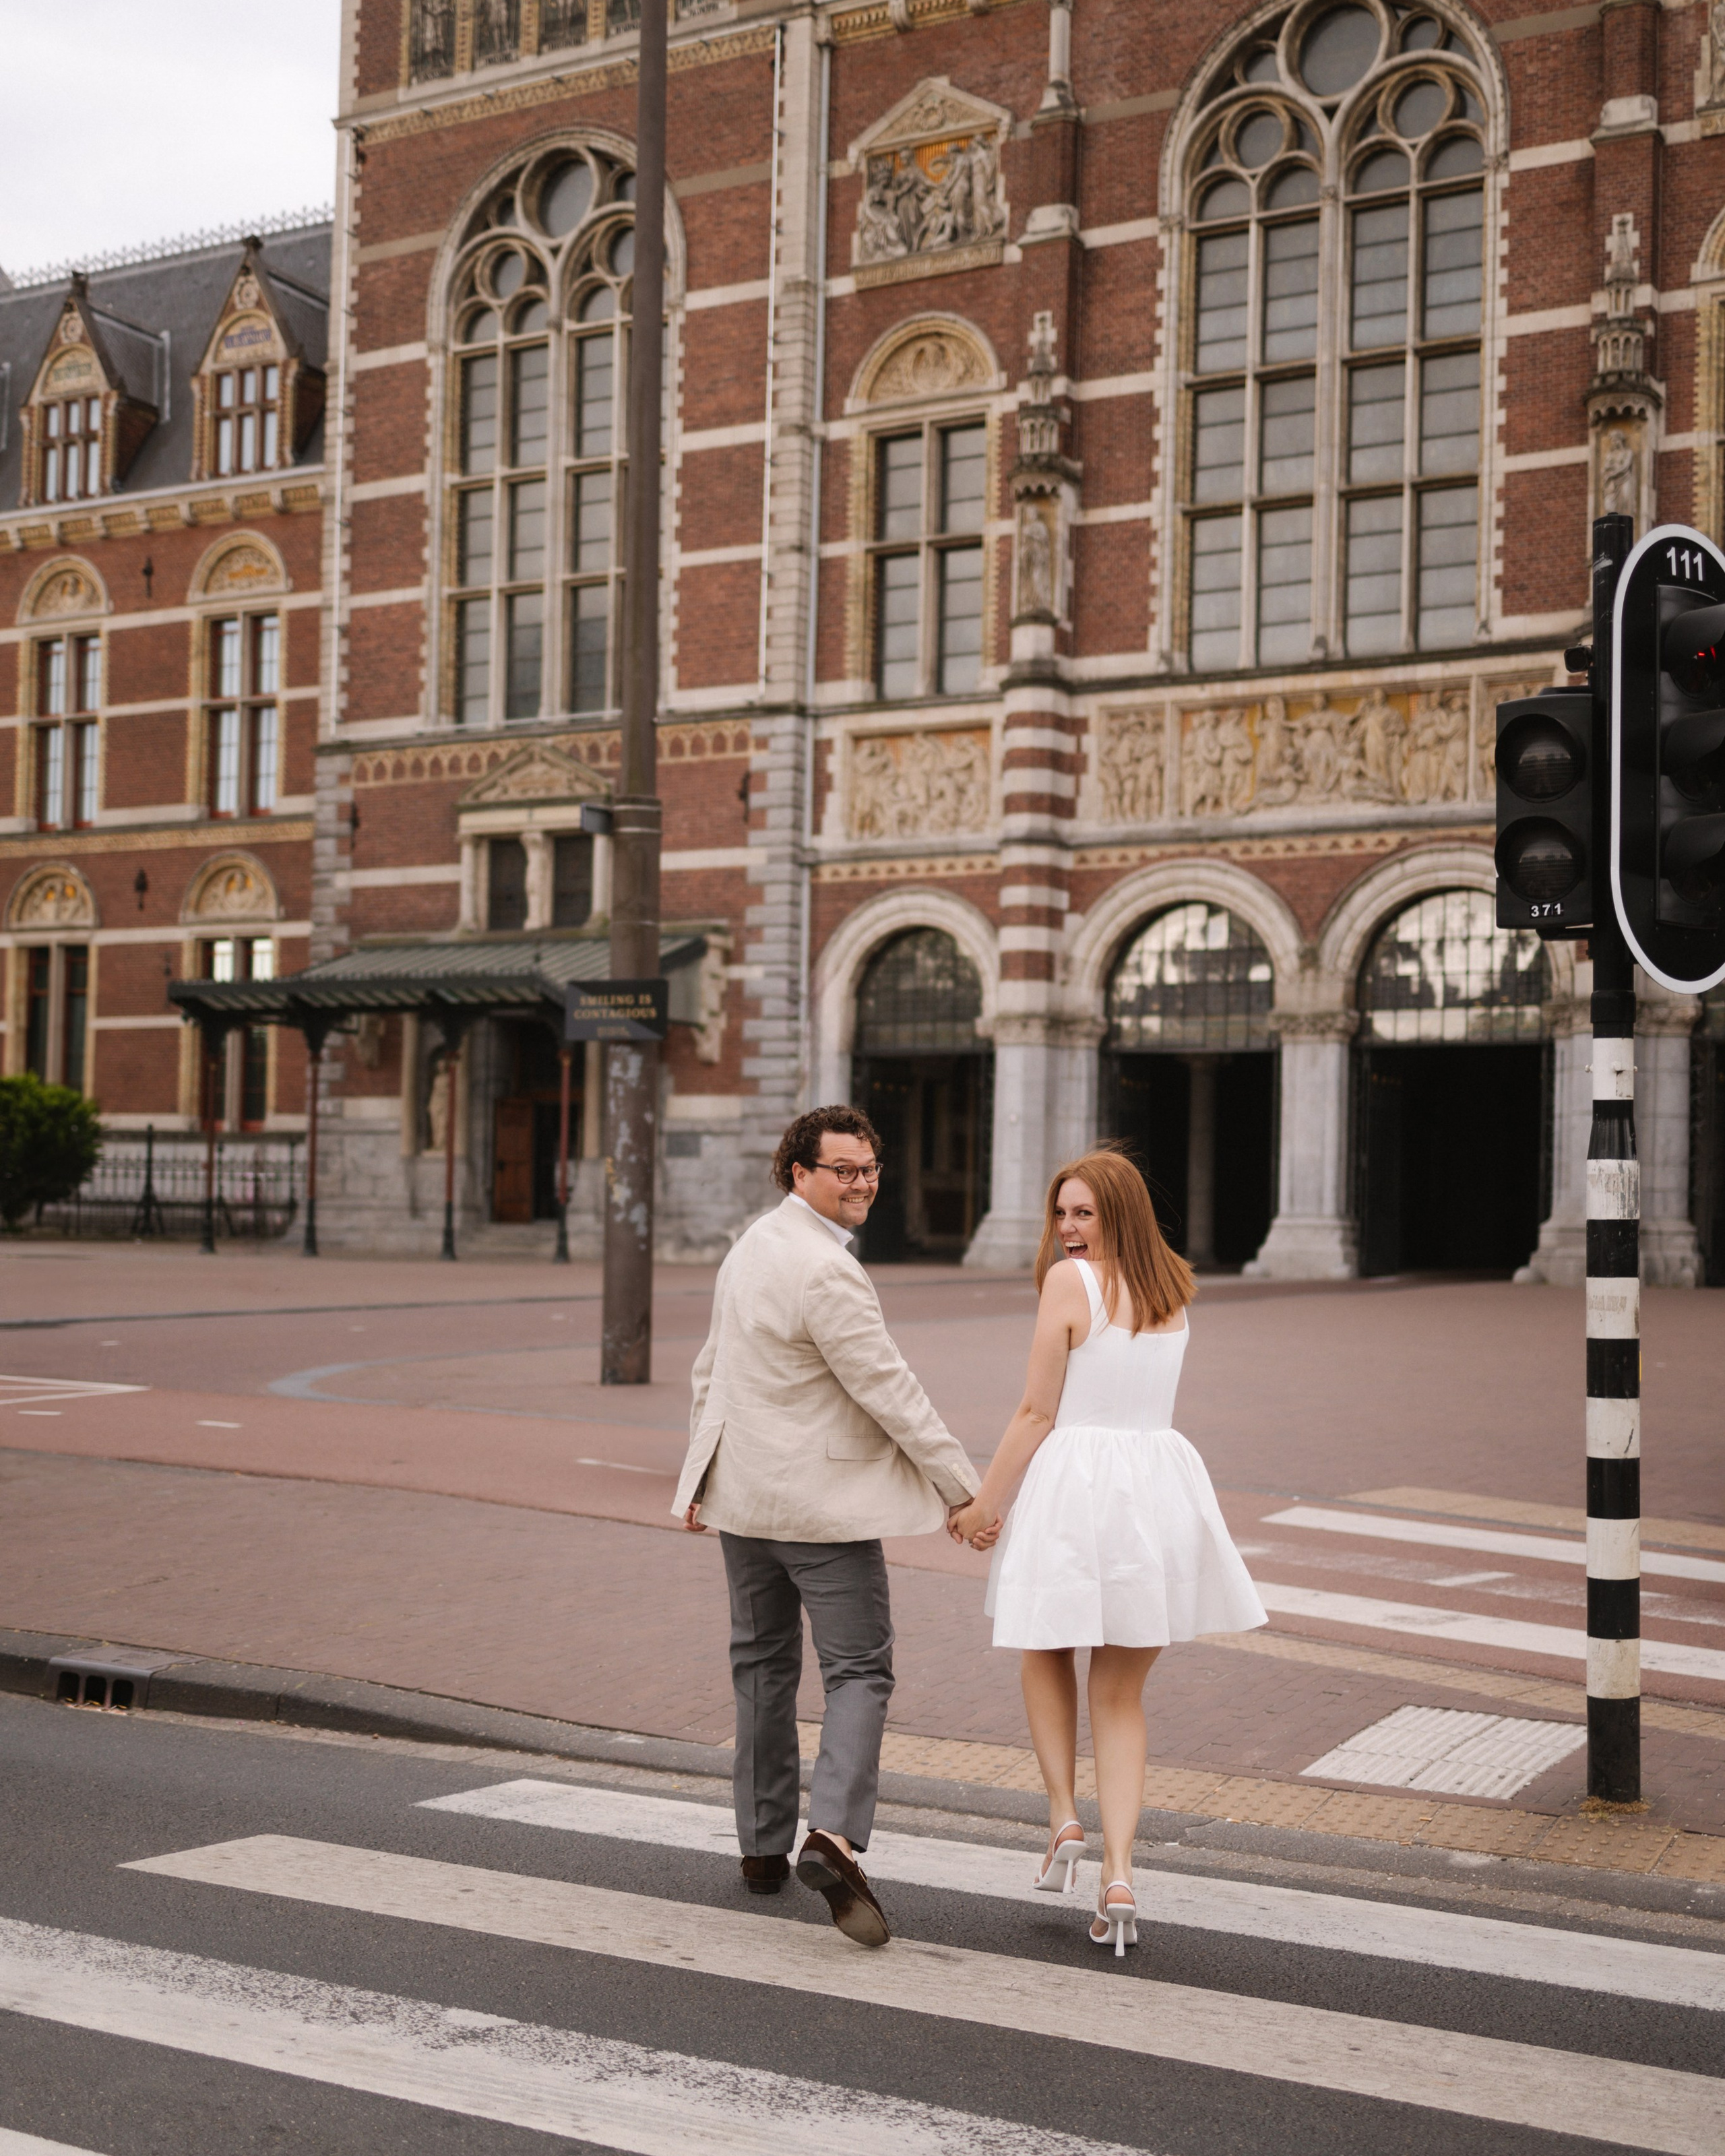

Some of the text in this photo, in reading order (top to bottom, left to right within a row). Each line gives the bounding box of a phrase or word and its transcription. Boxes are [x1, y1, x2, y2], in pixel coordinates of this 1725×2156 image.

[1666, 546, 1703, 581] 111
[1530, 903, 1561, 917] 371
[580, 994, 652, 1006] SMILING IS
[573, 1008, 657, 1019] CONTAGIOUS
